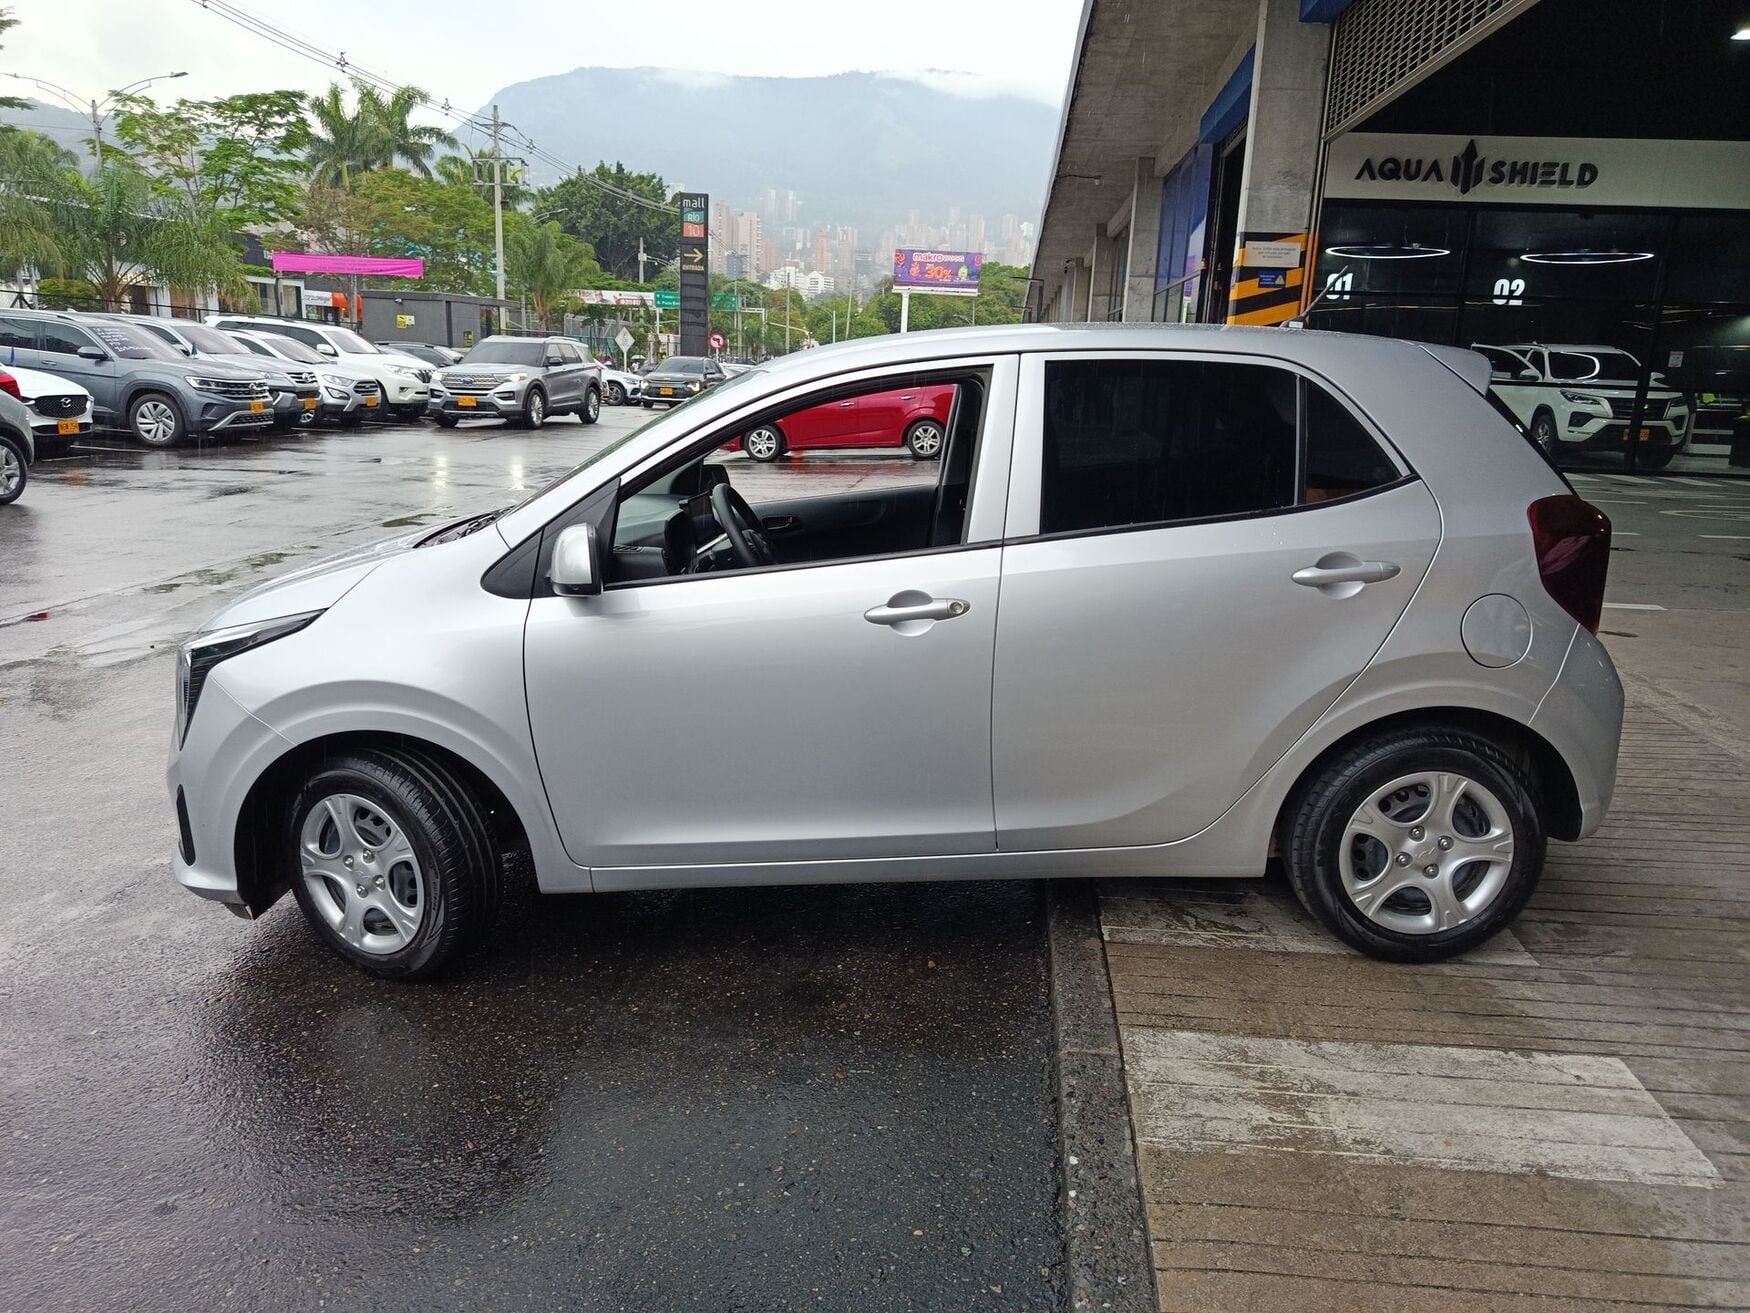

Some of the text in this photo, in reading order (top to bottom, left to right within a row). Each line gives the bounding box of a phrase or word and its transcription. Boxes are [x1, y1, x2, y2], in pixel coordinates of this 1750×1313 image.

[1354, 158, 1599, 187] AQUA SHIELD
[683, 197, 704, 208] mall
[913, 252, 943, 263] makro
[927, 266, 952, 279] 30%
[1325, 272, 1354, 300] 01
[1492, 278, 1526, 306] 02
